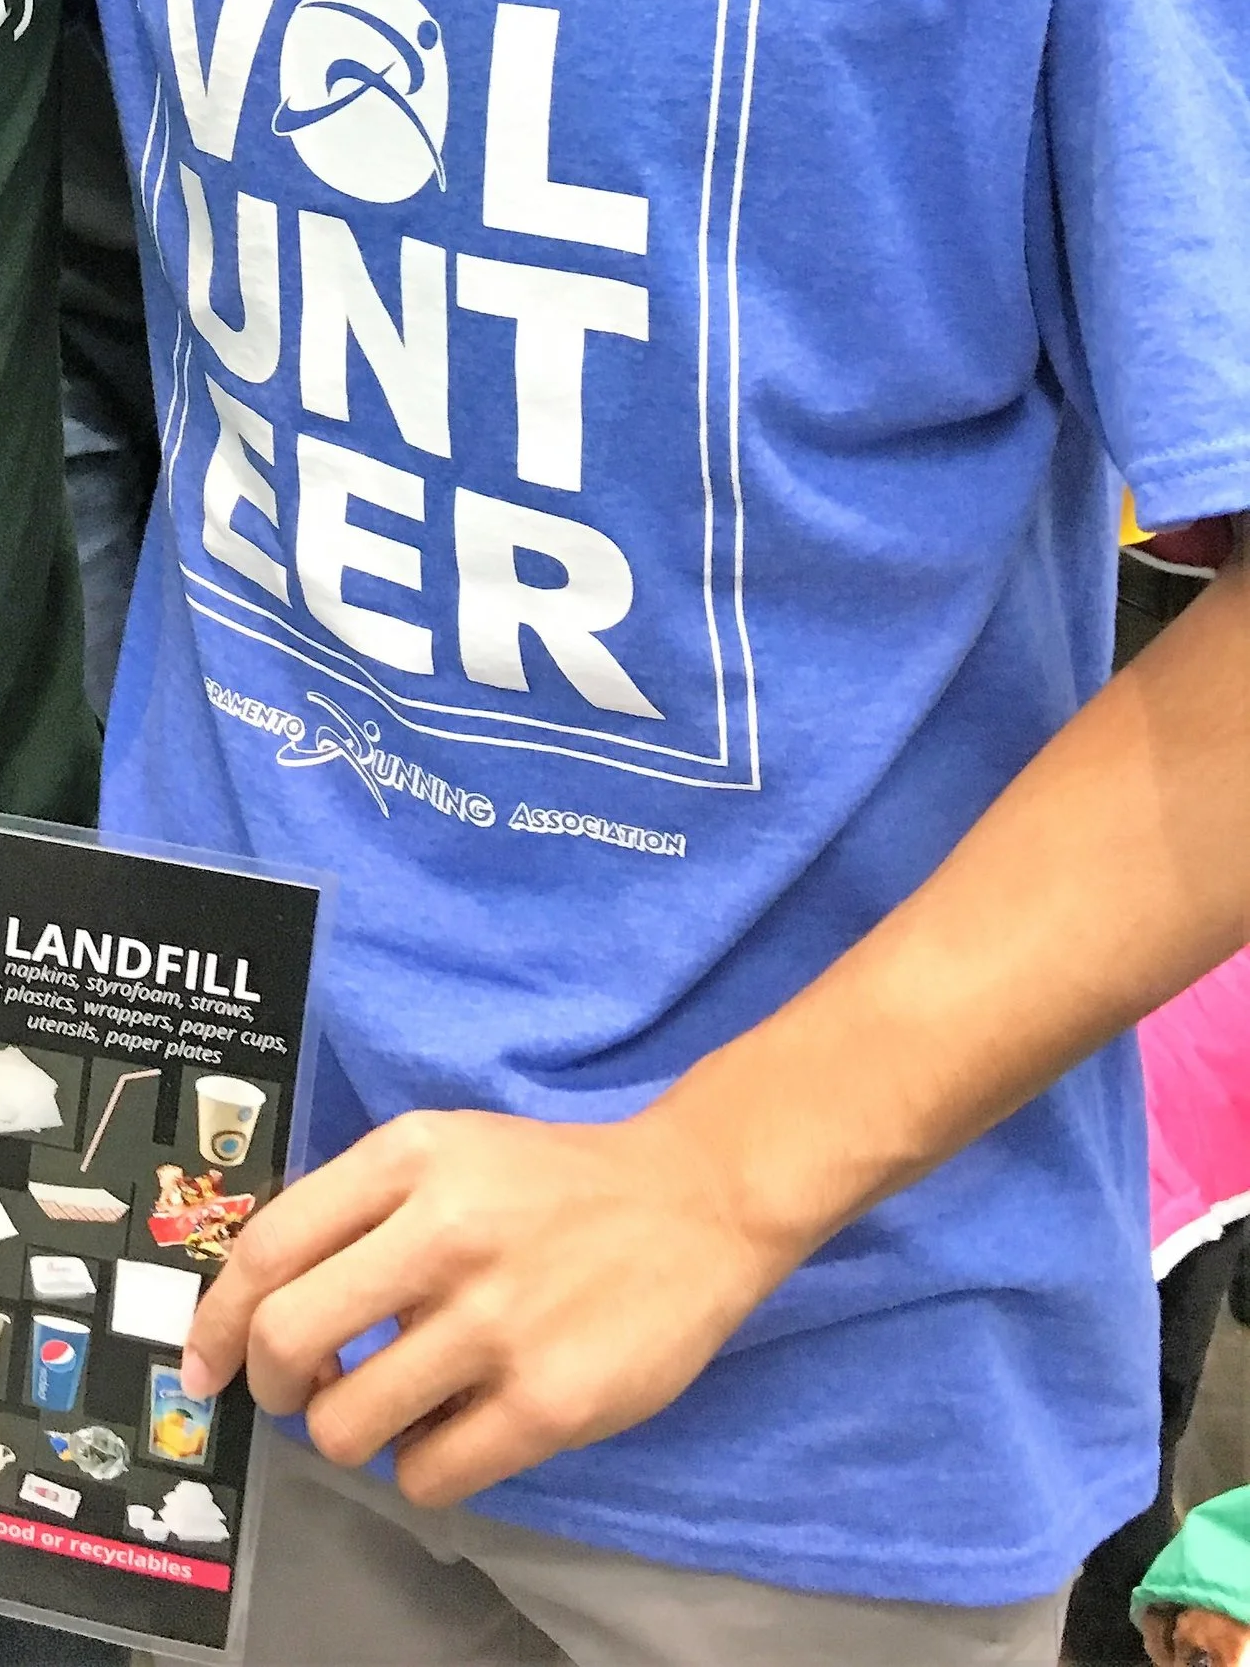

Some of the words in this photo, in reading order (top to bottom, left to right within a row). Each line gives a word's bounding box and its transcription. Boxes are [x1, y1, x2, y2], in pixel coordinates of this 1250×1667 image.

[179, 160, 649, 492] UNT
[202, 371, 667, 721] EER
[4, 916, 261, 1003] LANDFILL
[4, 960, 80, 991] napkins,
[85, 975, 185, 1011] styrofoam,
[189, 996, 255, 1023] straws,
[4, 983, 77, 1016] plastics,
[83, 1000, 174, 1033] wrappers,
[178, 1016, 237, 1042] paper
[239, 1029, 288, 1054] cups,
[27, 1013, 99, 1044] utensils,
[104, 1030, 162, 1055] paper
[164, 1038, 223, 1065] plates
[41, 1531, 64, 1549] or
[69, 1537, 193, 1579] recyclables
